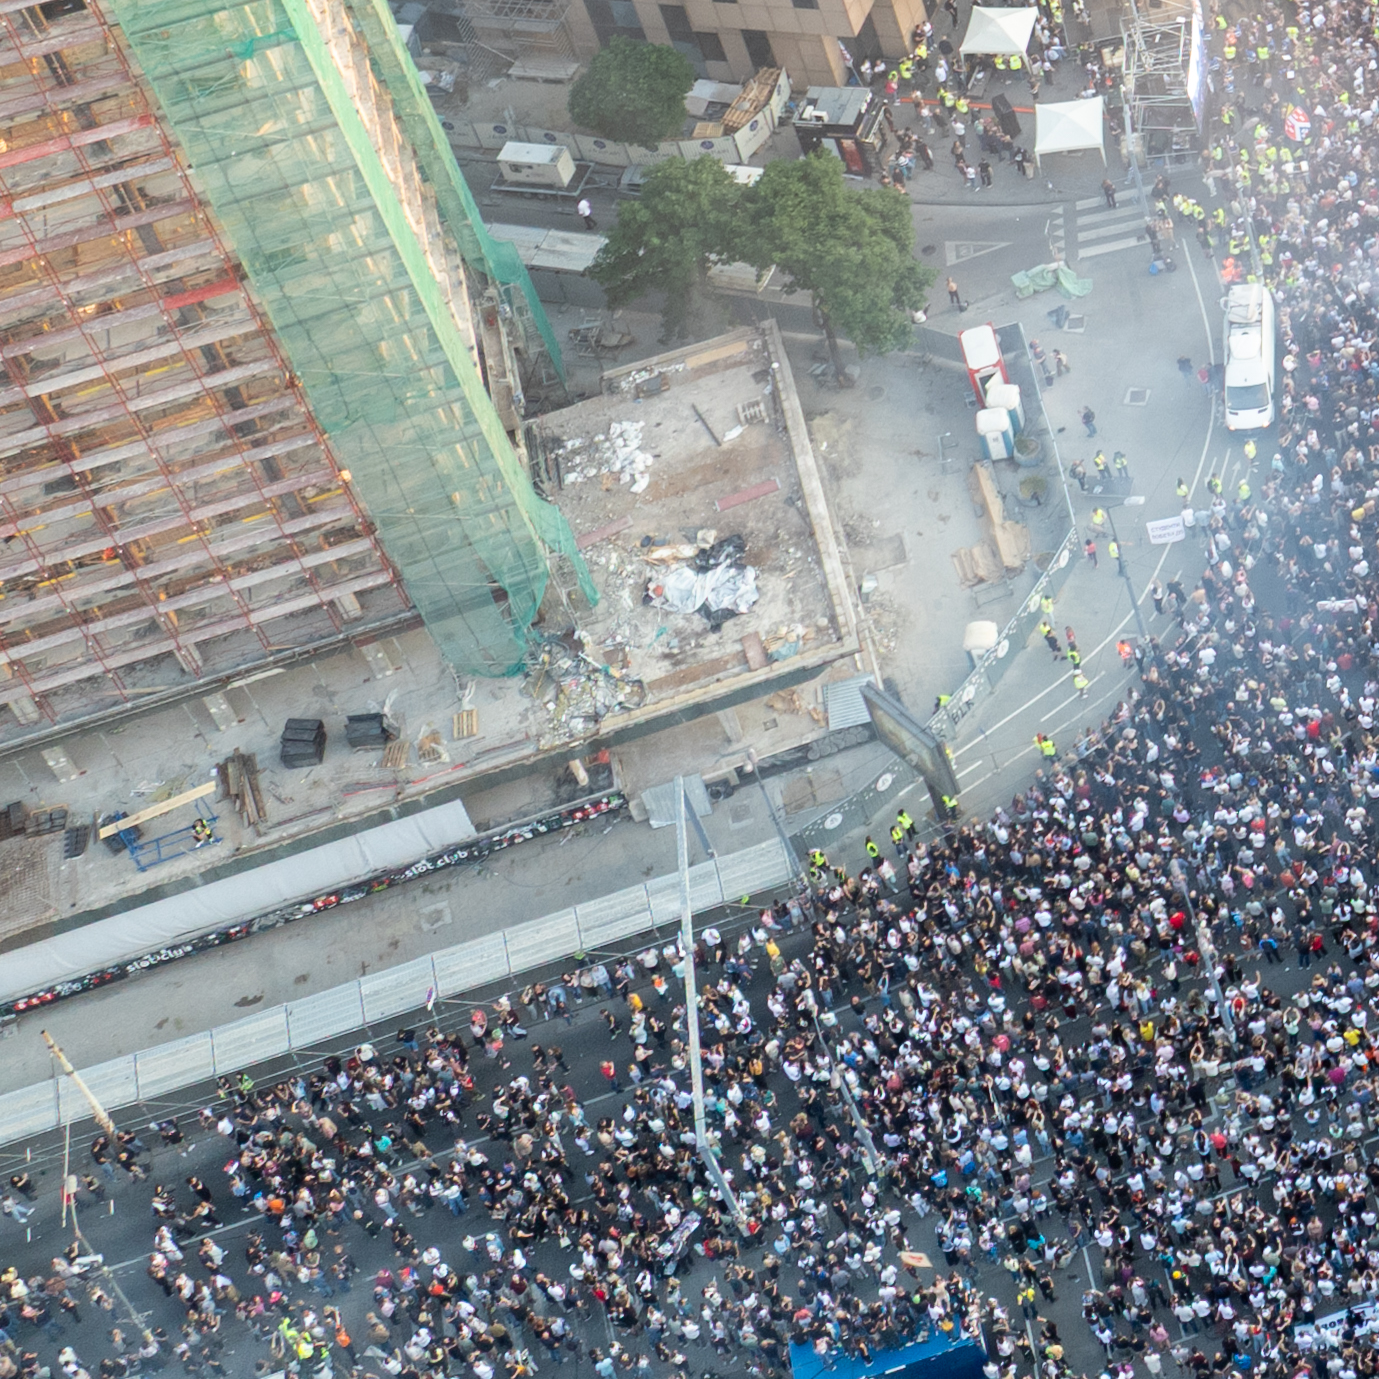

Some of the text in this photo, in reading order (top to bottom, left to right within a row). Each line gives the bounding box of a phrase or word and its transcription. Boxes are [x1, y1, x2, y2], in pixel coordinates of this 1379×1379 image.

[405, 849, 468, 878] slot club
[126, 944, 193, 973] slot club
